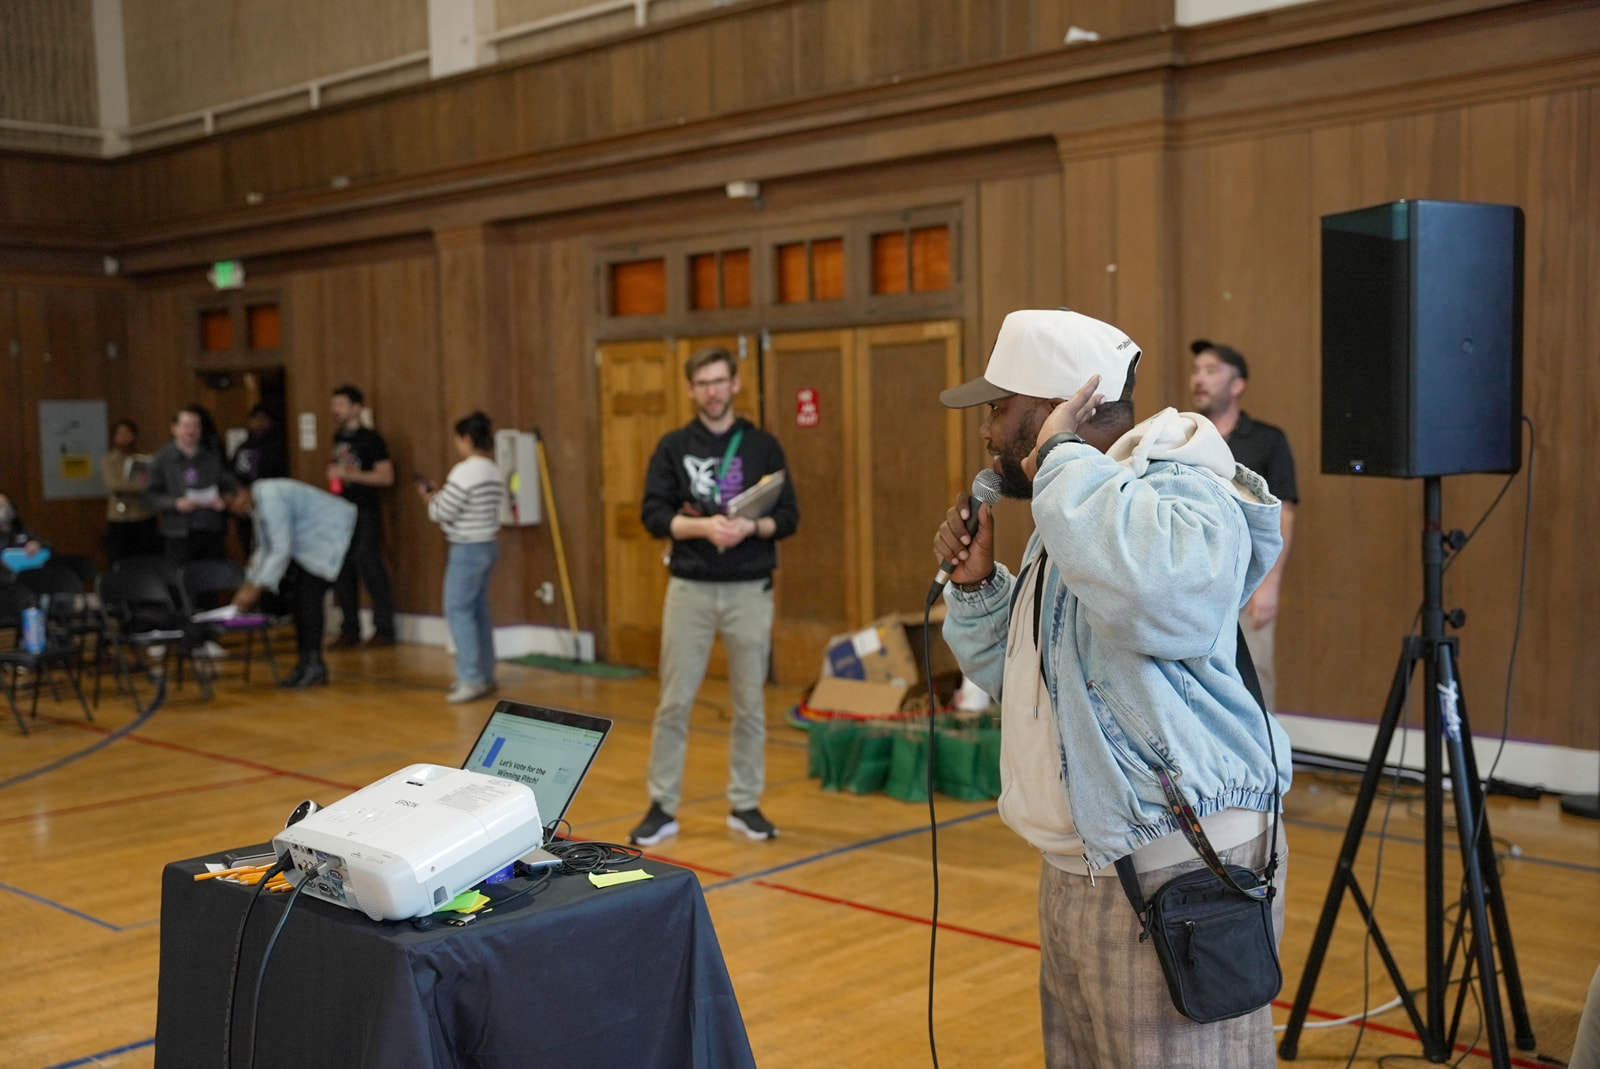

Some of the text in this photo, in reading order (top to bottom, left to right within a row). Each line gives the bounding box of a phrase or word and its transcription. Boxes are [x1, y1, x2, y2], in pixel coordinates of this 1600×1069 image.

[499, 759, 546, 775] Let's Vote for the
[497, 768, 539, 784] Winning Pitch!
